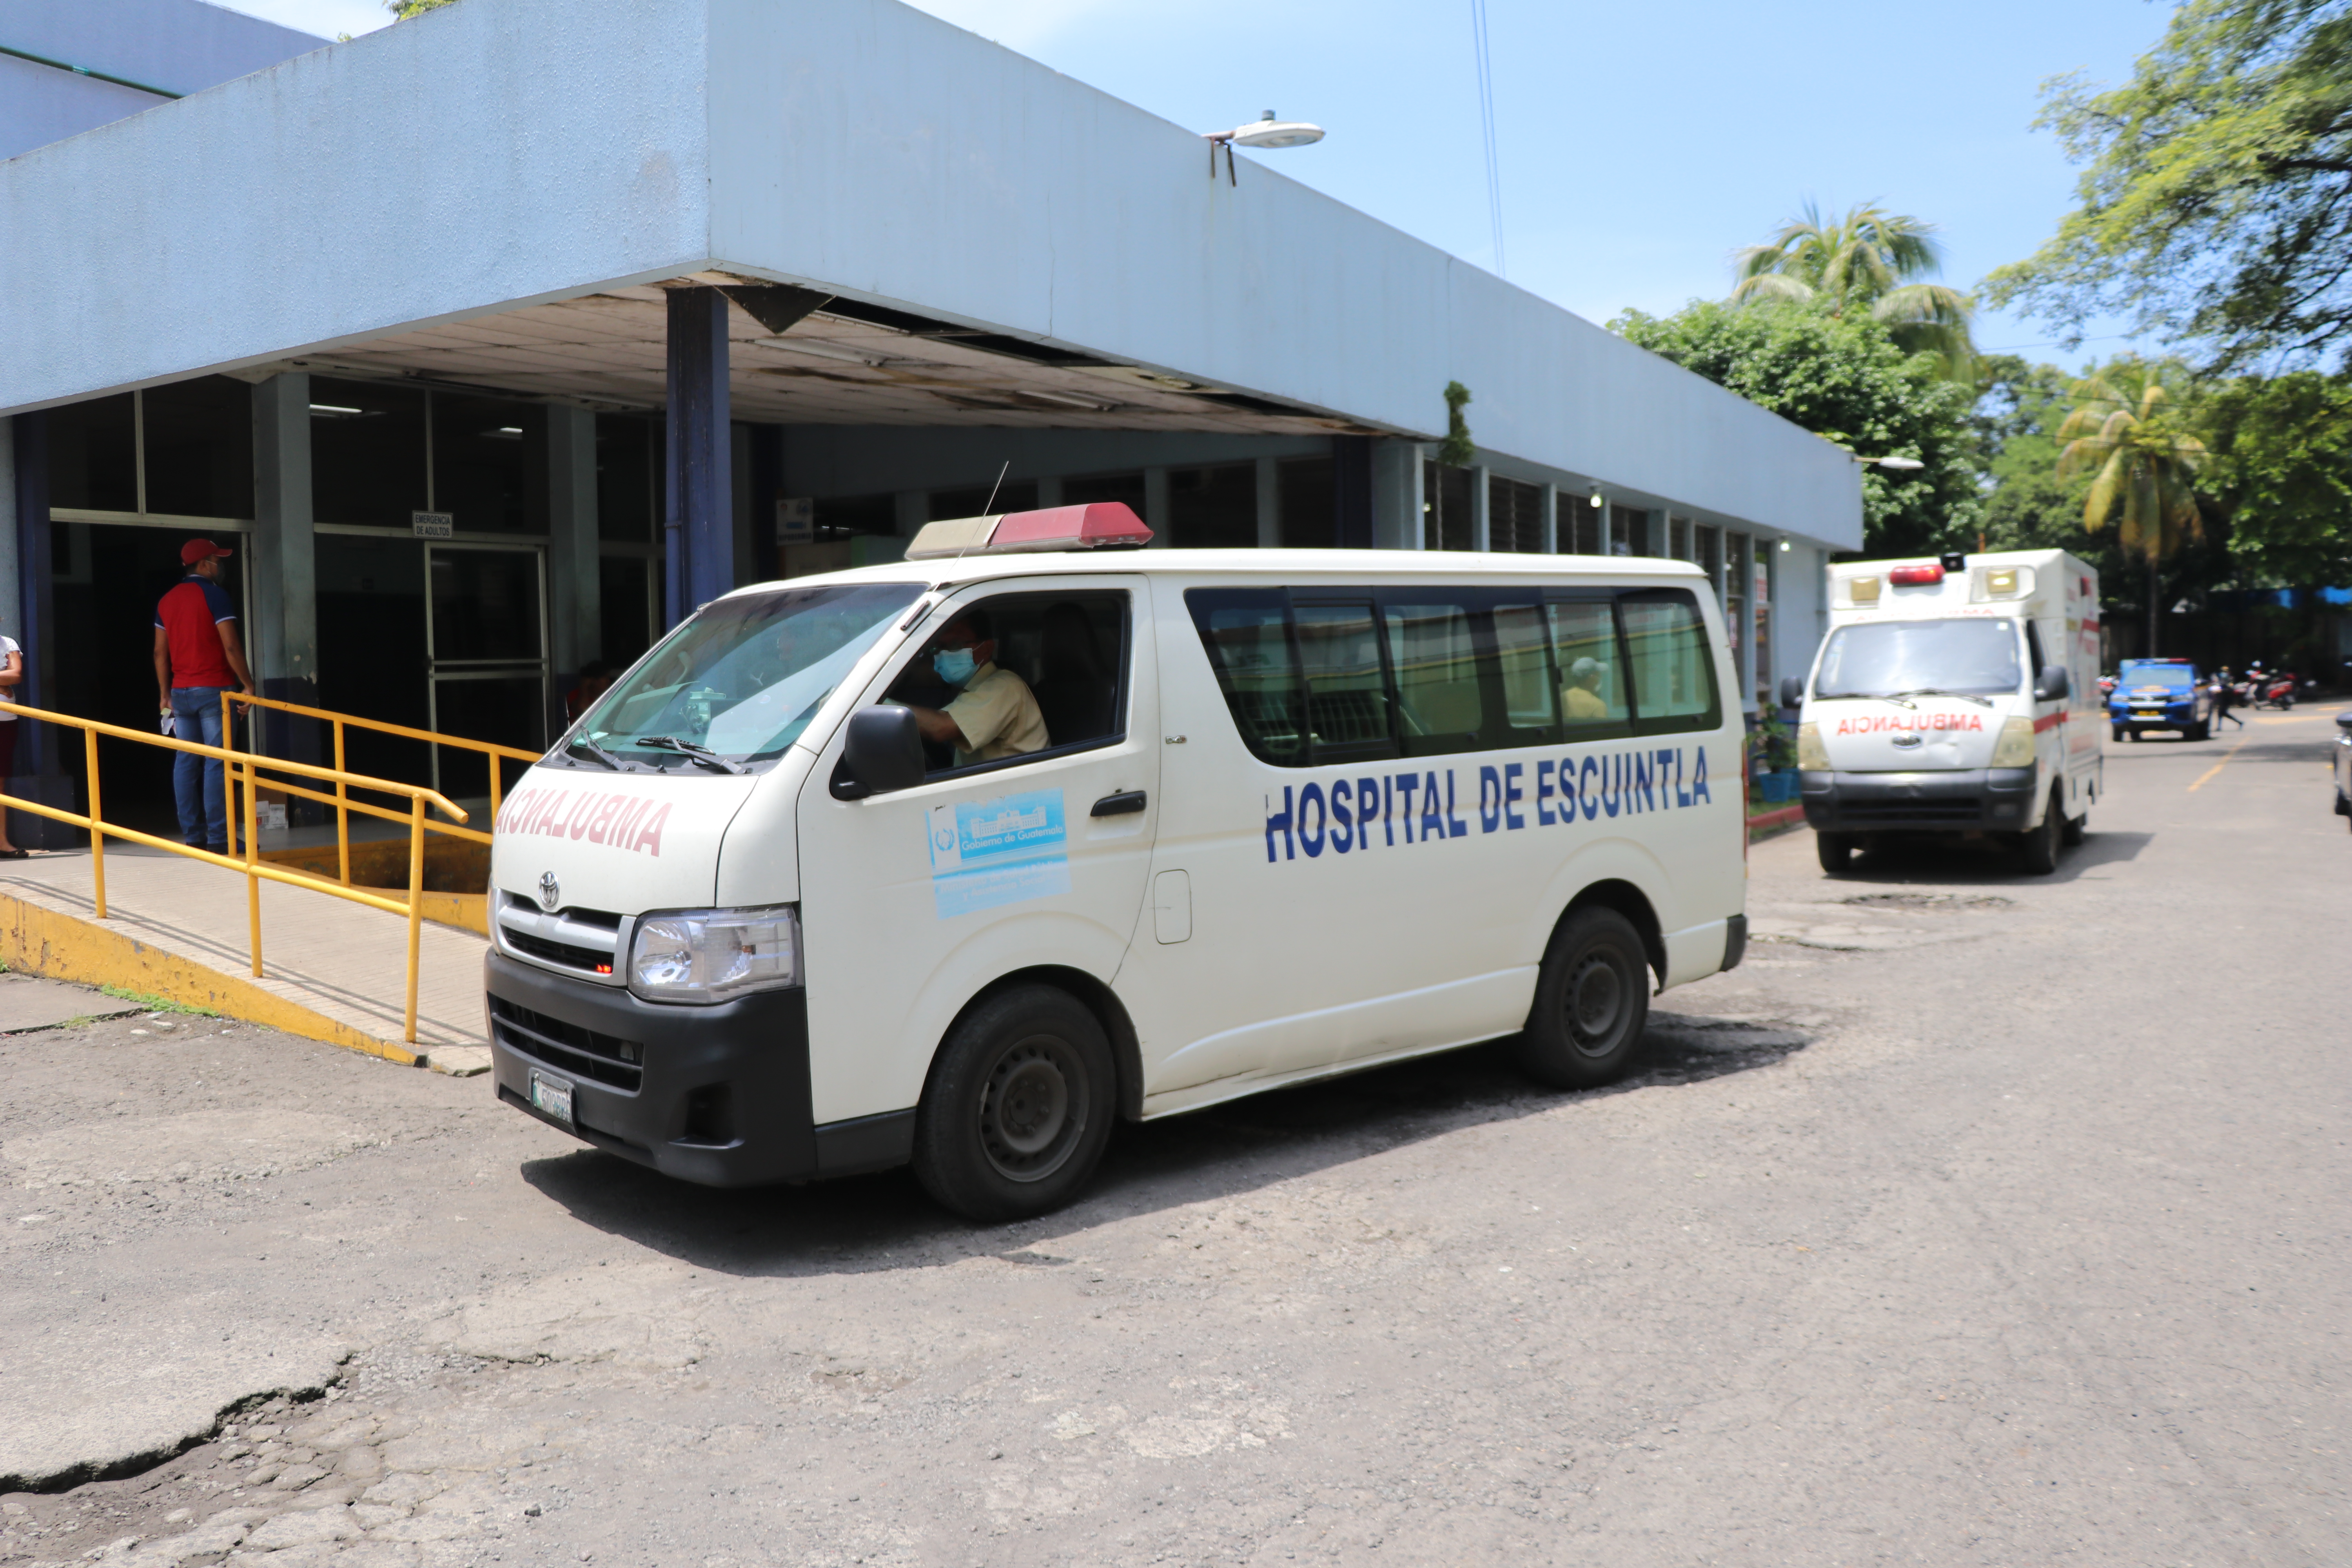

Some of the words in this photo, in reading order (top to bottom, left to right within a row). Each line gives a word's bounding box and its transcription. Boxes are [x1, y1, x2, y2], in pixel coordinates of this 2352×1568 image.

[416, 514, 450, 524] EMERGENCIA
[417, 526, 423, 534] DE
[425, 526, 450, 535] ADULTOS
[1266, 769, 1468, 863] HOSPITAL
[1480, 762, 1525, 833] DE
[1537, 746, 1711, 826] ESCUINTLA
[962, 838, 1002, 850] Gobierno
[1004, 833, 1016, 842] de
[1018, 825, 1063, 840] Guatemala
[971, 882, 1017, 897] Asistencia
[1020, 875, 1045, 887] Social
